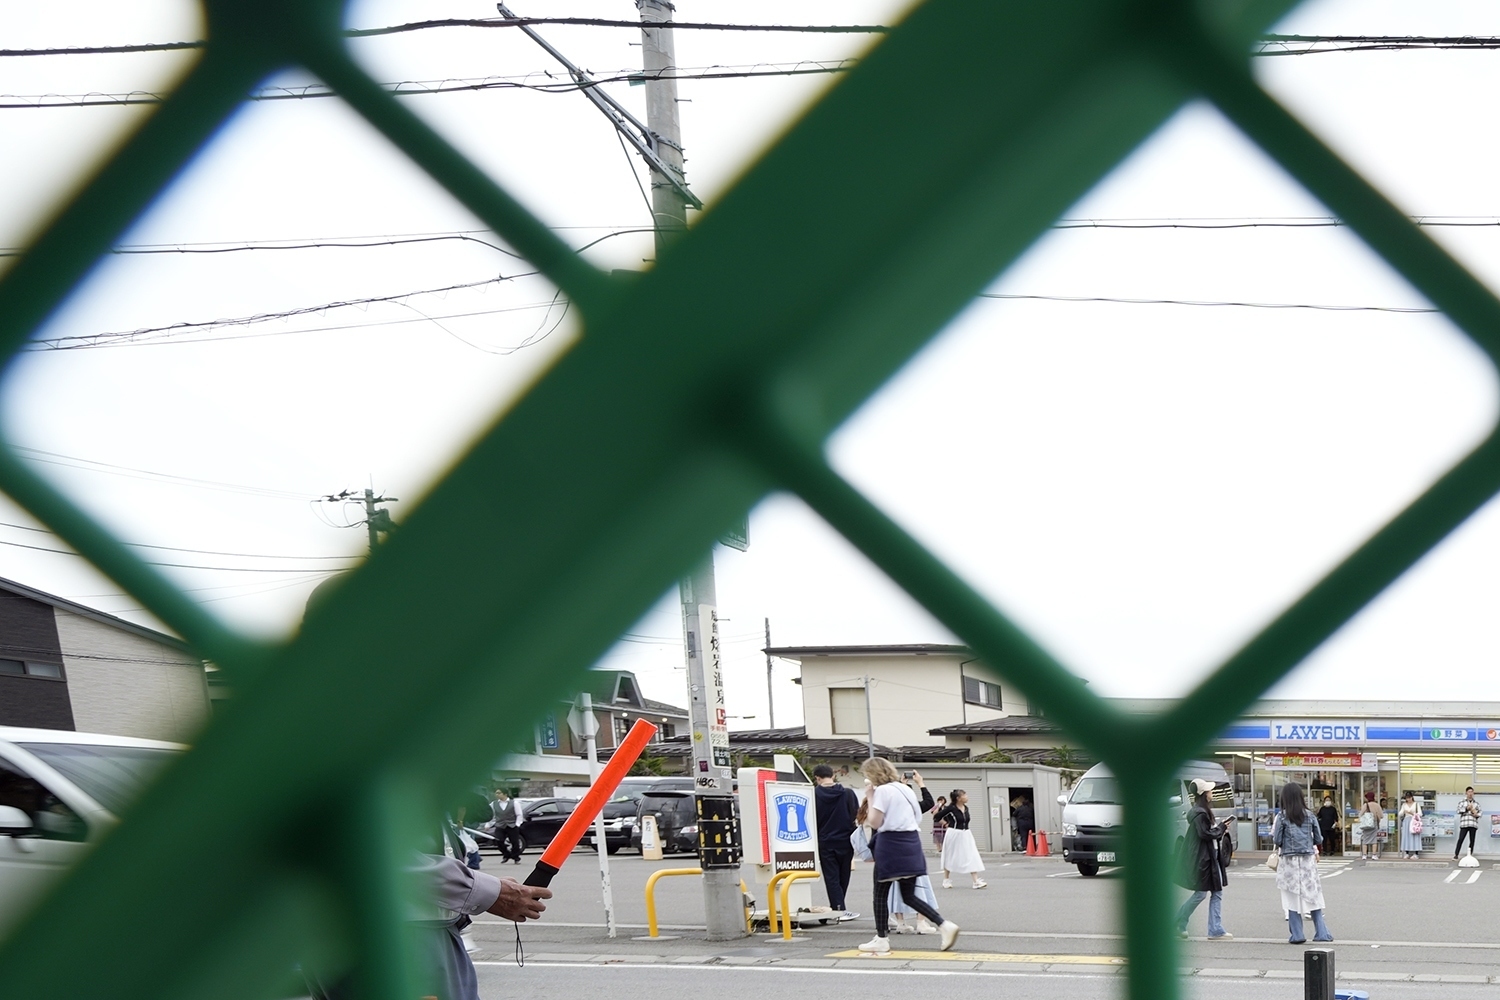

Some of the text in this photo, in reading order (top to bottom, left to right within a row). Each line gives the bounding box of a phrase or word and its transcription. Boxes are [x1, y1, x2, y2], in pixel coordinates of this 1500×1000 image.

[1275, 725, 1360, 740] LAWSON
[1444, 730, 1463, 738] 野菜
[776, 794, 807, 807] LAWSON
[778, 830, 808, 841] STATION
[776, 859, 815, 870] MACHI café
